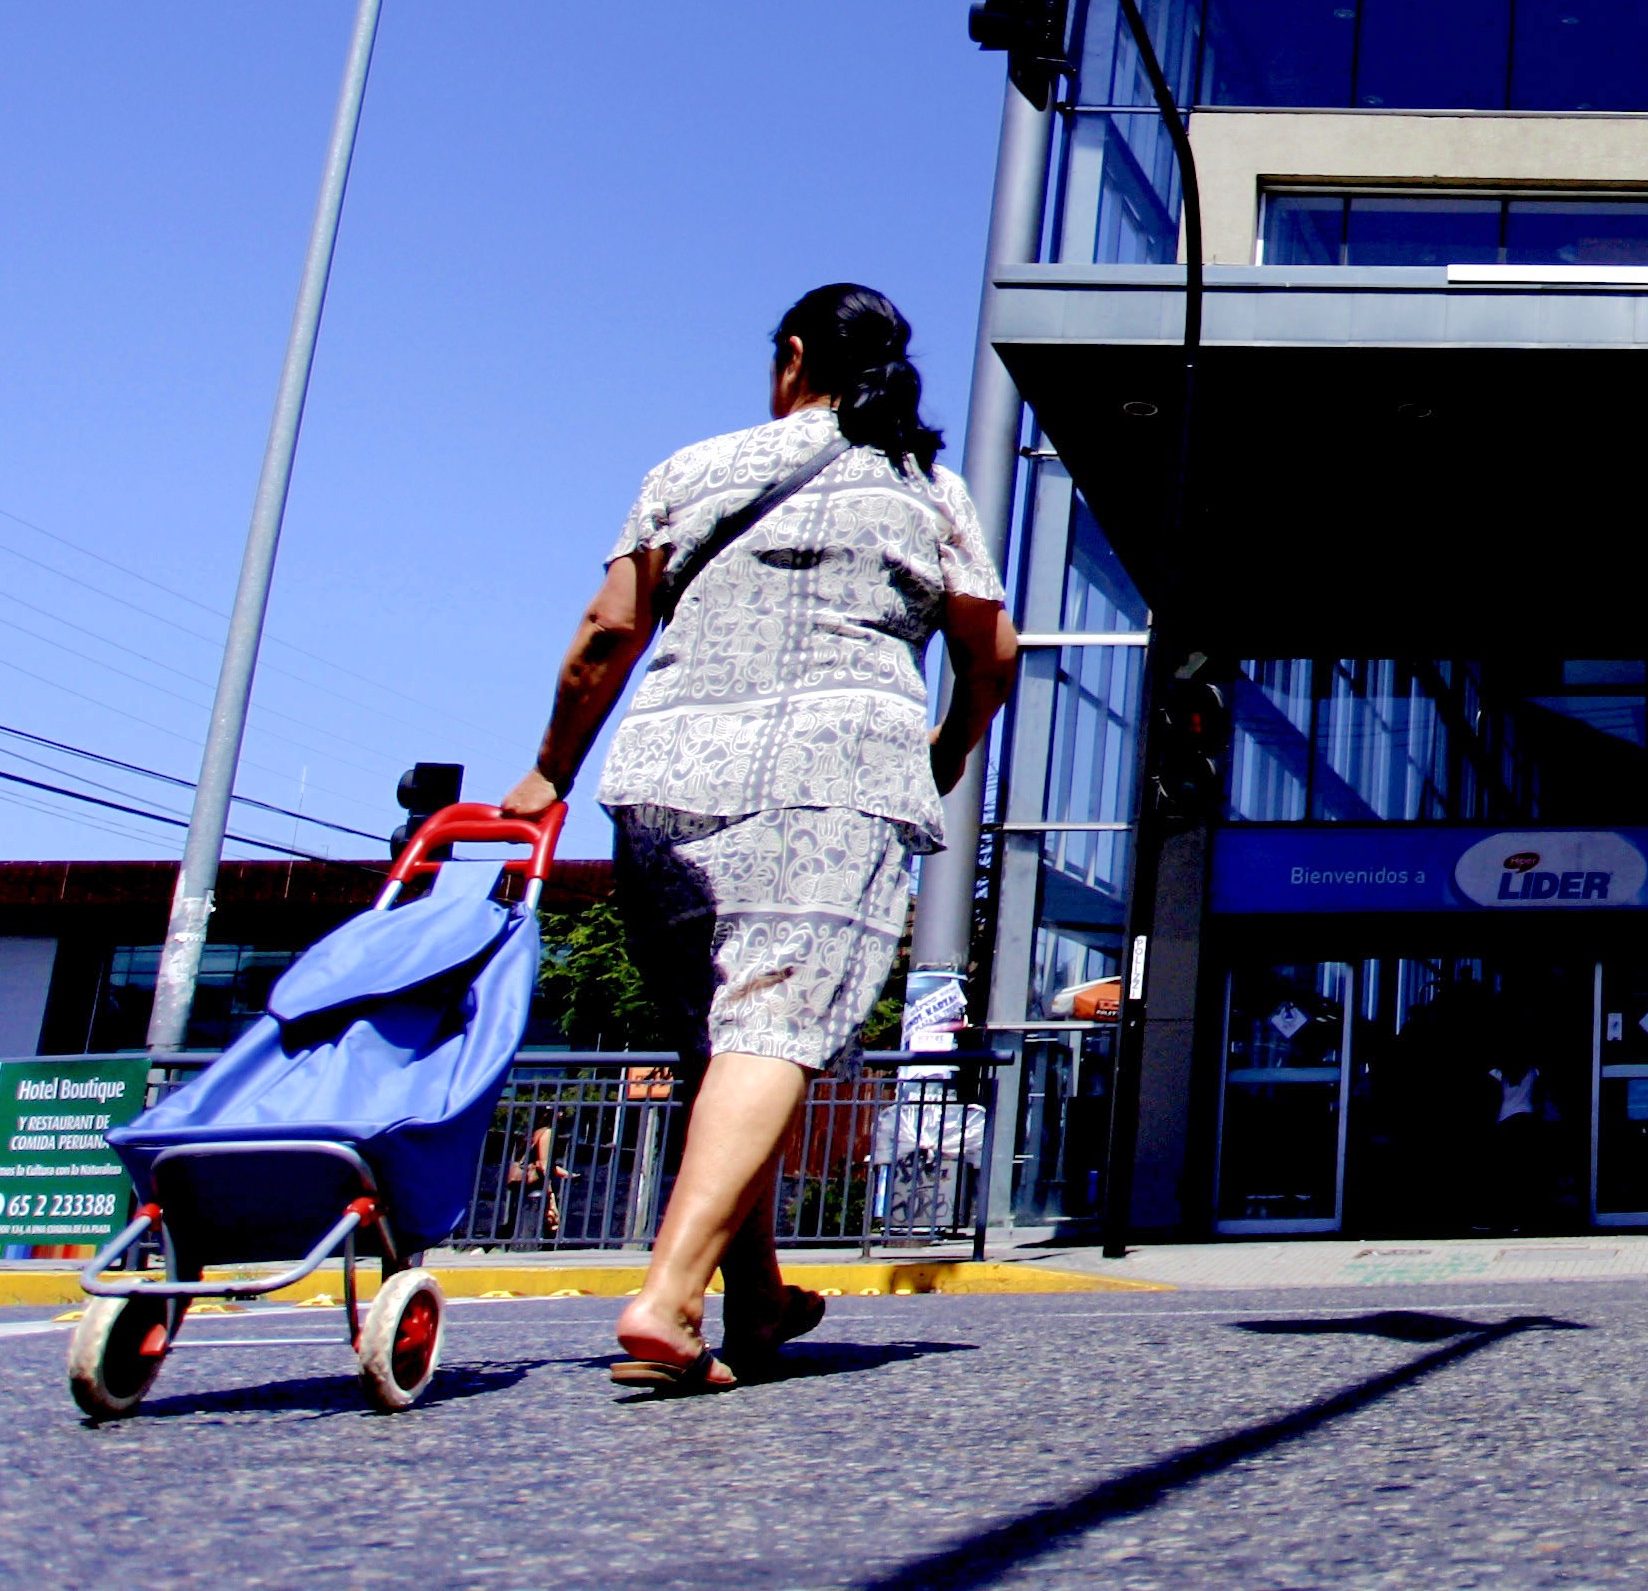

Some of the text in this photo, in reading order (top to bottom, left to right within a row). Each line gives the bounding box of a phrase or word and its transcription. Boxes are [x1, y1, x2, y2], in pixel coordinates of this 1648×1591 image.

[1291, 867, 1426, 884] Bienvenidos a
[1497, 871, 1612, 900] LIDER
[17, 1076, 126, 1103] Hotel Boutique
[18, 1114, 111, 1130] Y RESTAURANT DE
[9, 1135, 55, 1150] COMIDA
[8, 1193, 116, 1217] 65 2 233388
